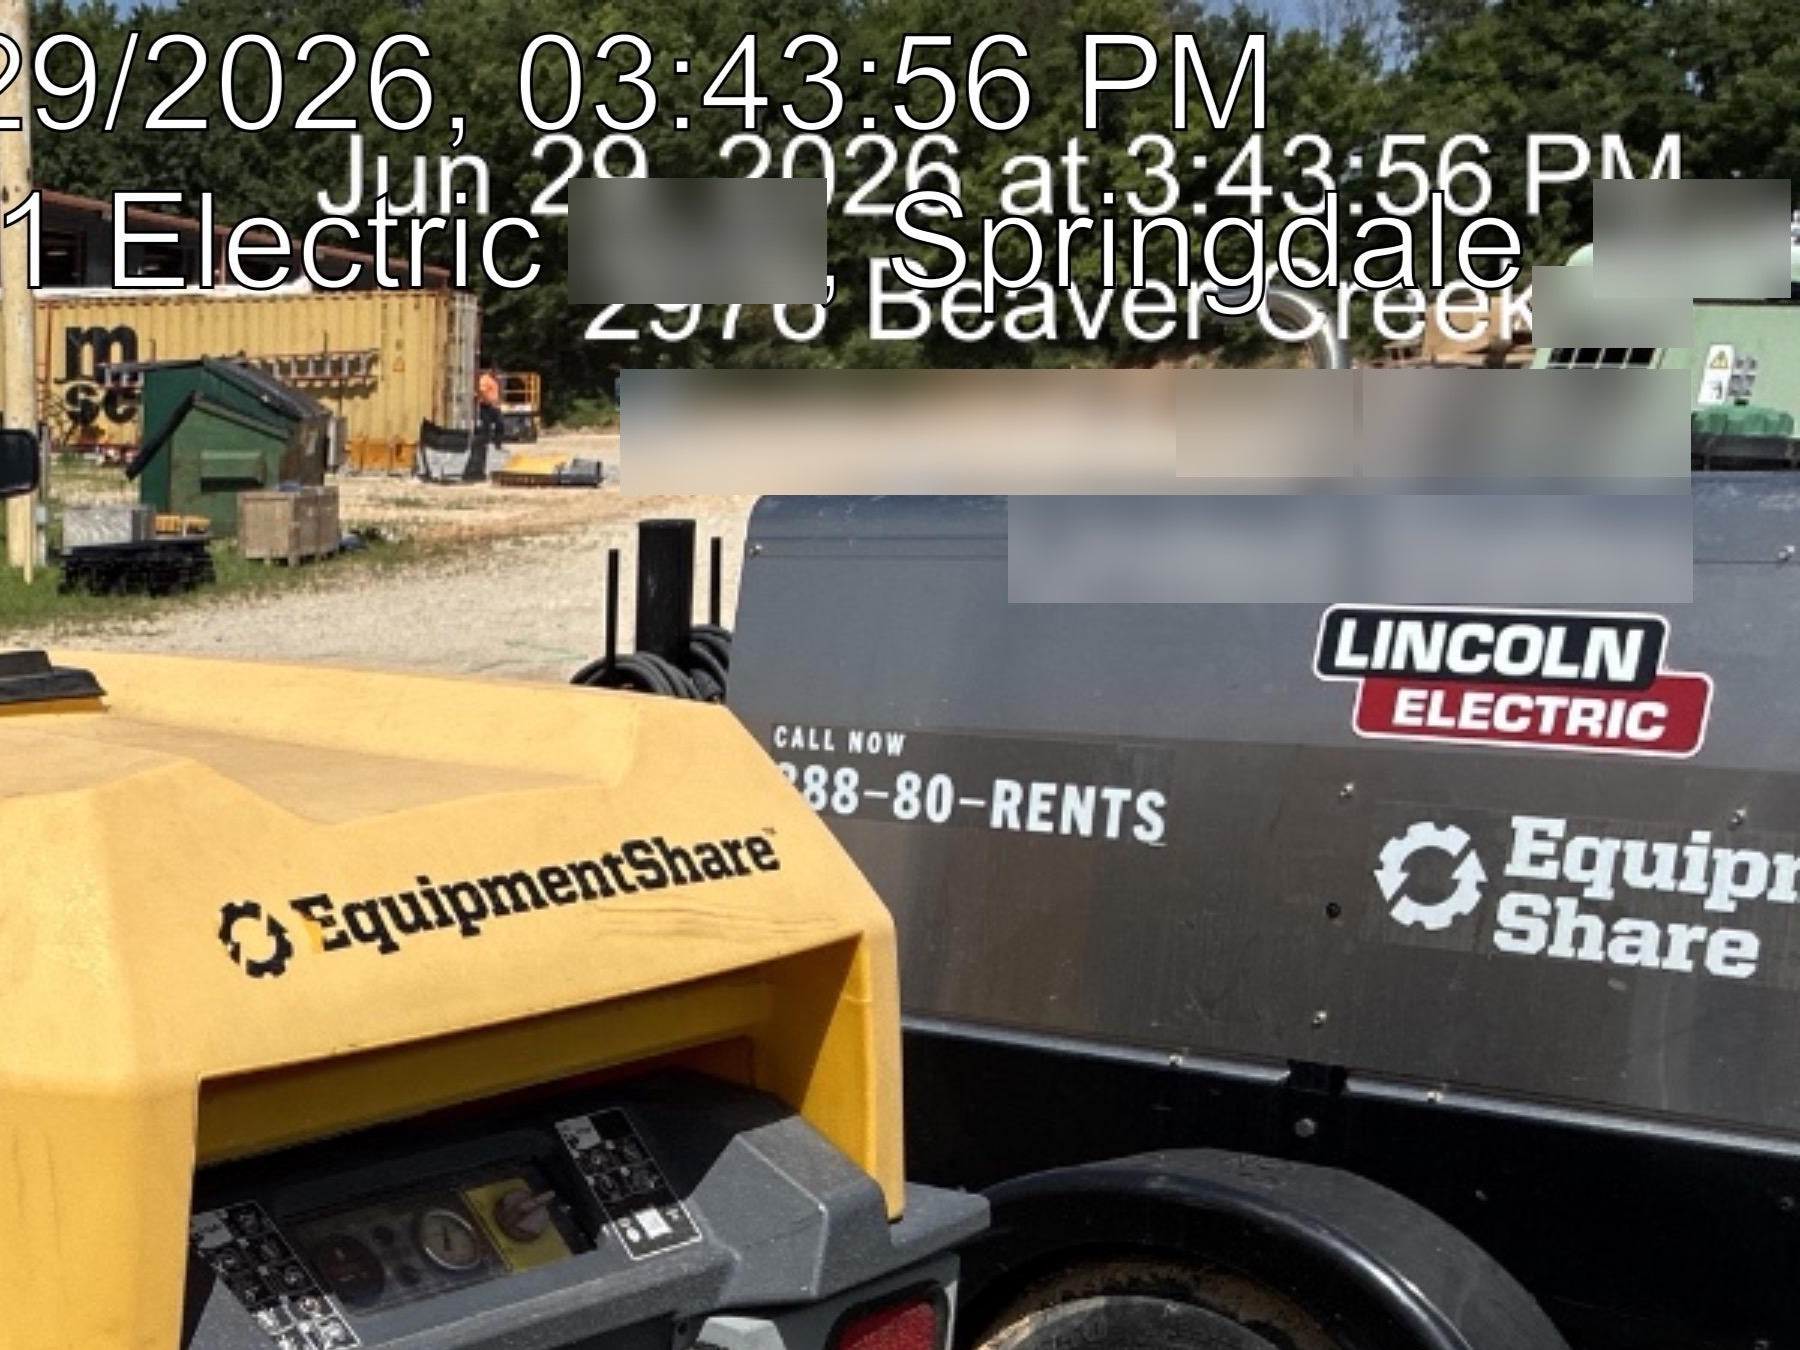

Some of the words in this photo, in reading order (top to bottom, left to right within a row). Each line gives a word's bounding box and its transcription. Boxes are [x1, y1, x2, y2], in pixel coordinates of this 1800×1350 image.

[1334, 617, 1645, 683] LINCOLN
[773, 725, 835, 753] CALL
[848, 729, 906, 757] NOW
[1392, 688, 1669, 742] ELECTRIC
[1493, 891, 1761, 980] Share
